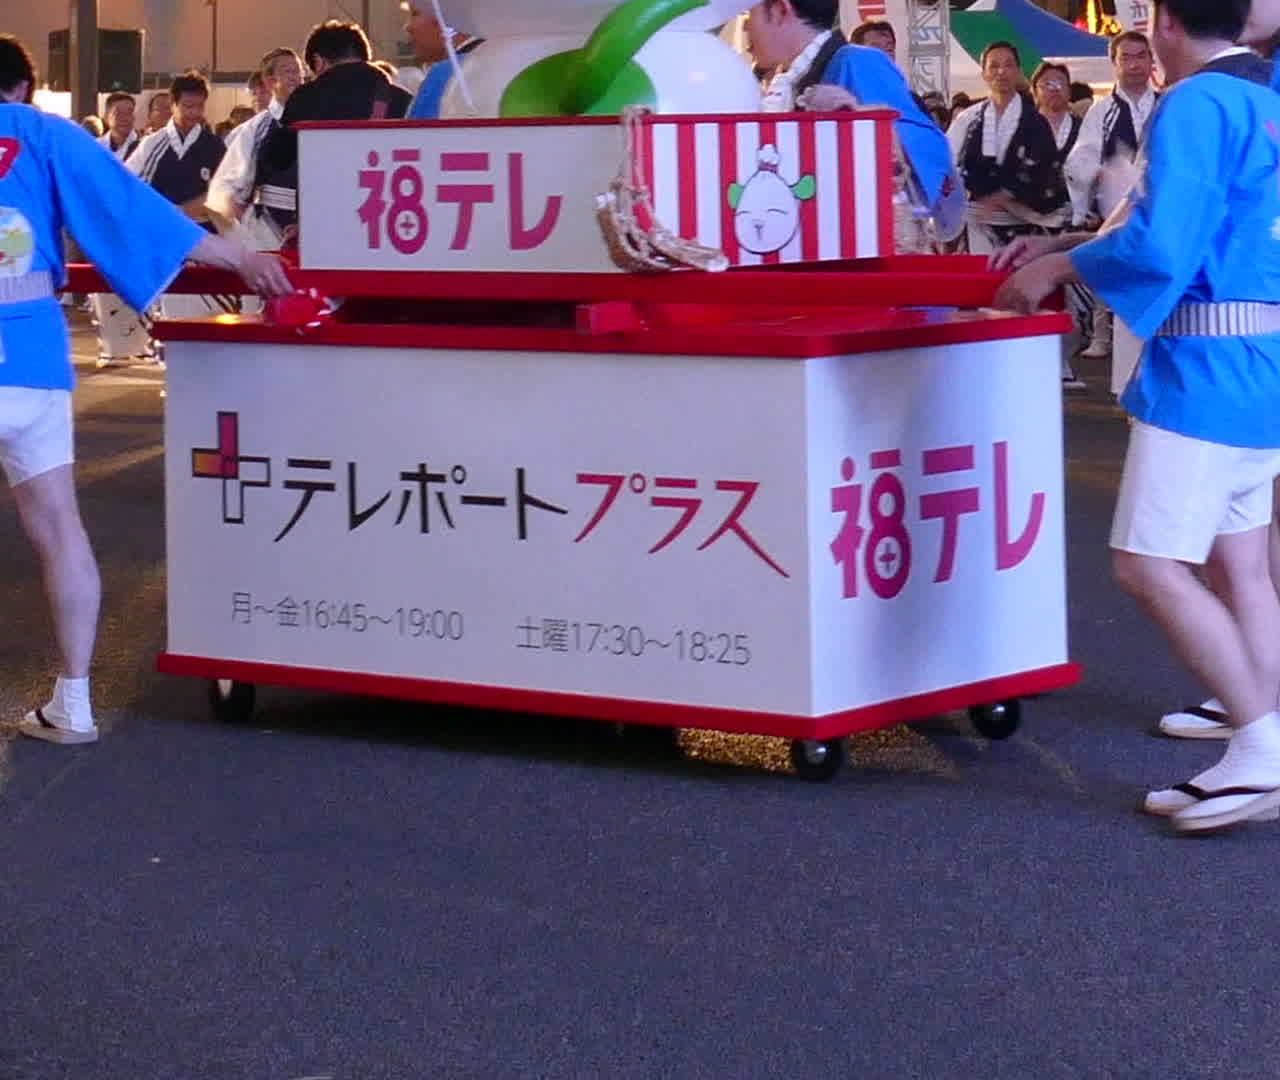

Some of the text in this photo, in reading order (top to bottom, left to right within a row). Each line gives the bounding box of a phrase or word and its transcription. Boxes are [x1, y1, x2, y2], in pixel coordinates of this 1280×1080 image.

[357, 149, 563, 255] 福テレ
[273, 456, 792, 579] テレポートプラス
[829, 440, 1045, 600] 福テレ
